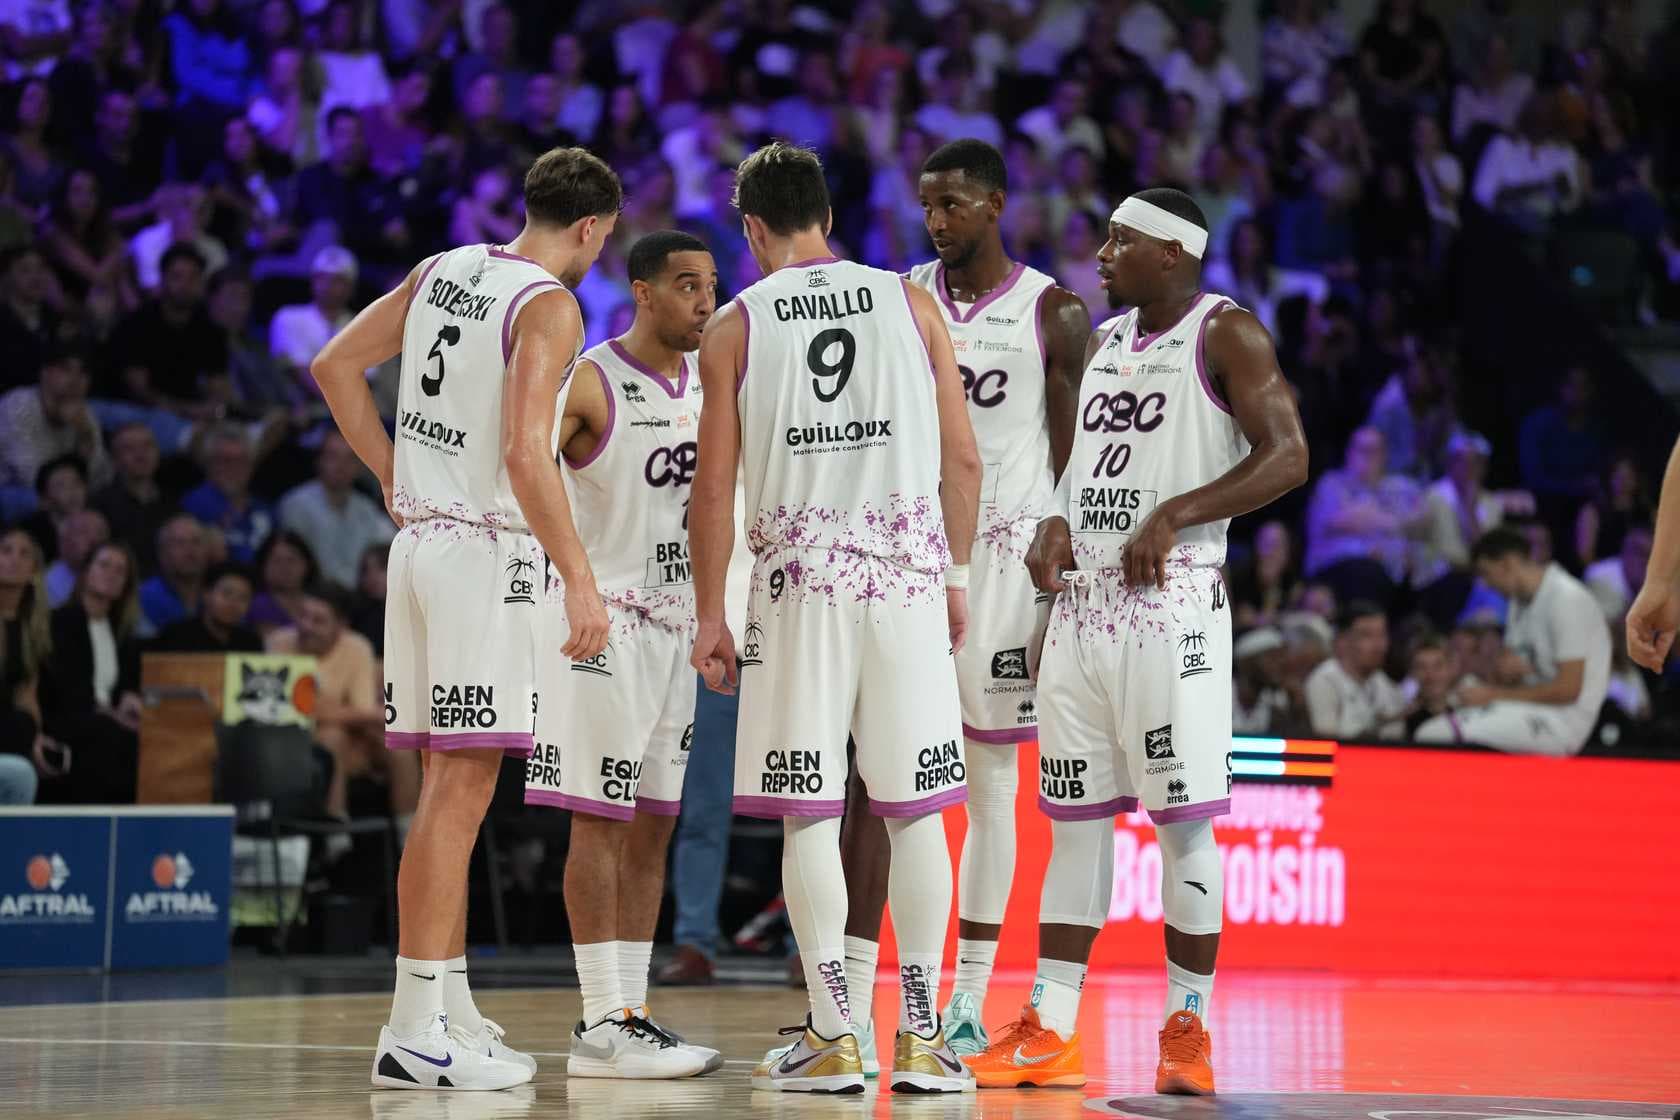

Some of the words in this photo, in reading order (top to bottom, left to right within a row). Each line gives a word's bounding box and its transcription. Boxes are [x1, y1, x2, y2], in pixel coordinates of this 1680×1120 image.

[774, 287, 874, 322] CAVALLO
[421, 324, 461, 397] 5
[807, 328, 856, 403] 9
[957, 364, 1009, 408] BC
[1083, 390, 1168, 433] CBC
[401, 409, 467, 449] UiLLOUX
[842, 441, 887, 452] construction
[644, 441, 698, 488] CB
[1093, 443, 1131, 478] 10
[1080, 487, 1141, 510] BRAVIS
[1080, 510, 1132, 532] IMMO
[664, 564, 691, 583] IM
[770, 568, 785, 599] 9
[1210, 580, 1226, 612] 10
[580, 653, 608, 668] BC
[1183, 652, 1206, 668] CBC
[432, 684, 494, 706] CAEN
[431, 707, 497, 728] REPRO
[532, 742, 561, 766] AEN
[765, 750, 821, 771] CAEN
[918, 739, 960, 769] CAEN
[525, 762, 561, 788] EPRO
[600, 756, 643, 781] EQU
[915, 761, 966, 792] REPRO
[1041, 756, 1088, 779] QUIP
[1145, 761, 1185, 775] ORMDIE
[602, 779, 641, 802] CL
[761, 772, 823, 794] REPRO
[1167, 793, 1190, 805] errea
[0, 893, 95, 915] AFTRAL
[125, 891, 219, 914] AFTRAL
